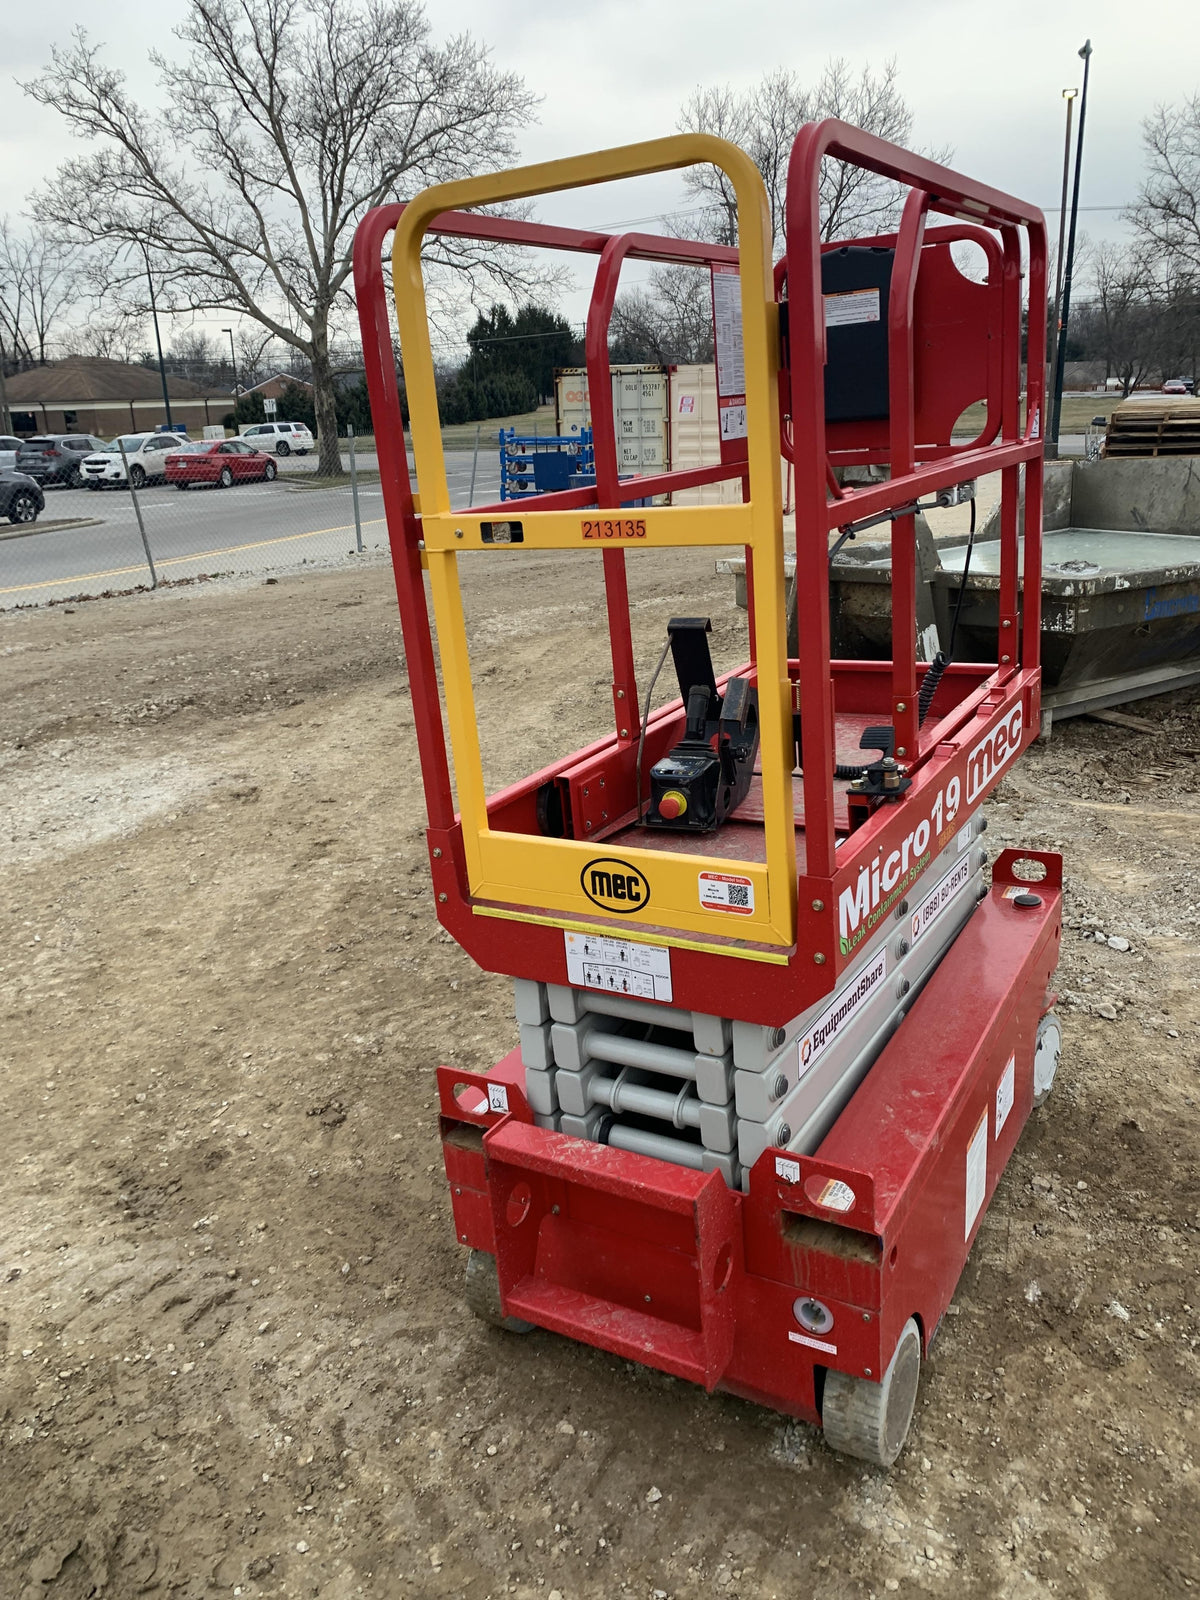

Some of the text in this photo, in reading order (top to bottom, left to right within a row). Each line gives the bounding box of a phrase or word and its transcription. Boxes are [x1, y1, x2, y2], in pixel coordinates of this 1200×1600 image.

[583, 520, 646, 538] 213135
[848, 851, 931, 952] Leak Containment System
[922, 892, 940, 924] (888)
[940, 862, 968, 902] 80-RENTS
[813, 963, 883, 1052] EquipmentShare
